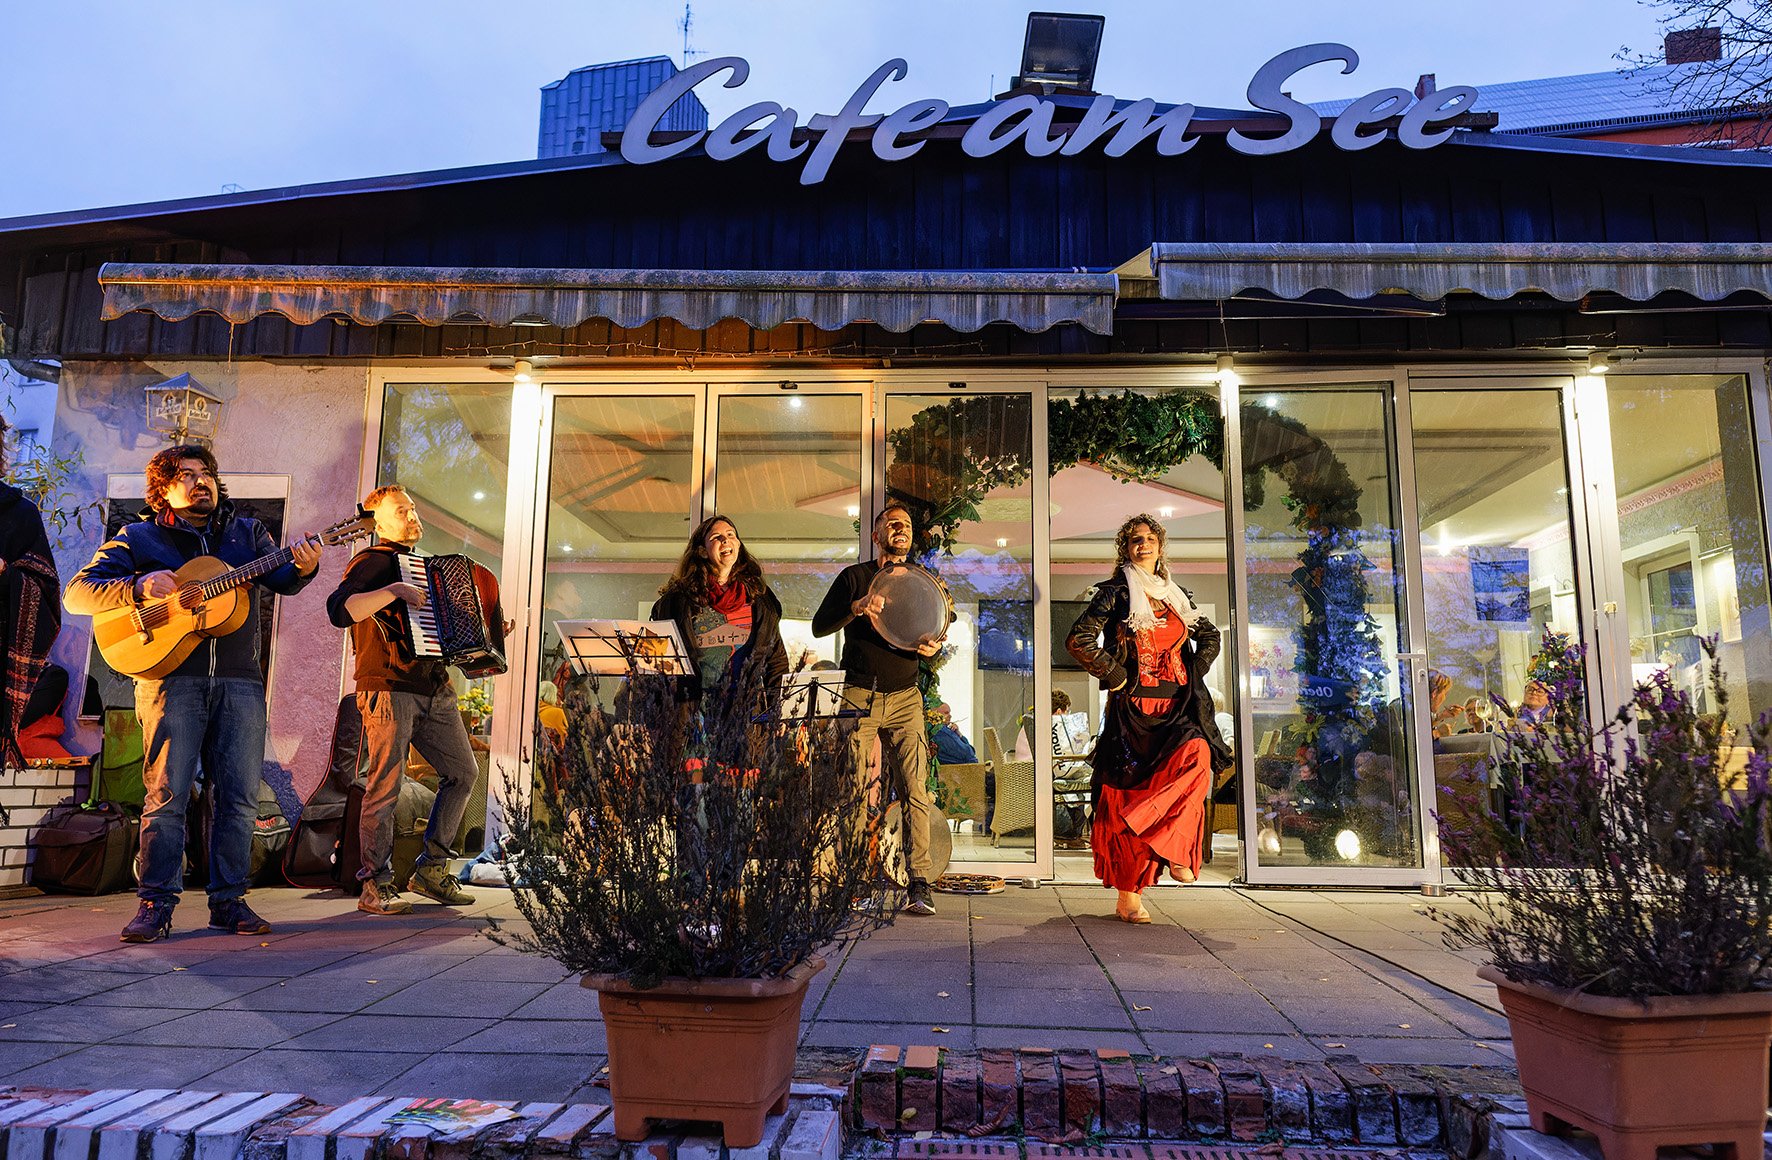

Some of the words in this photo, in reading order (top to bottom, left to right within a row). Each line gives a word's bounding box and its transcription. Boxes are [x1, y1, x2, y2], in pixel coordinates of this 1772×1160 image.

[620, 57, 950, 186] Cafe
[961, 94, 1200, 158] am
[1226, 42, 1479, 156] See
